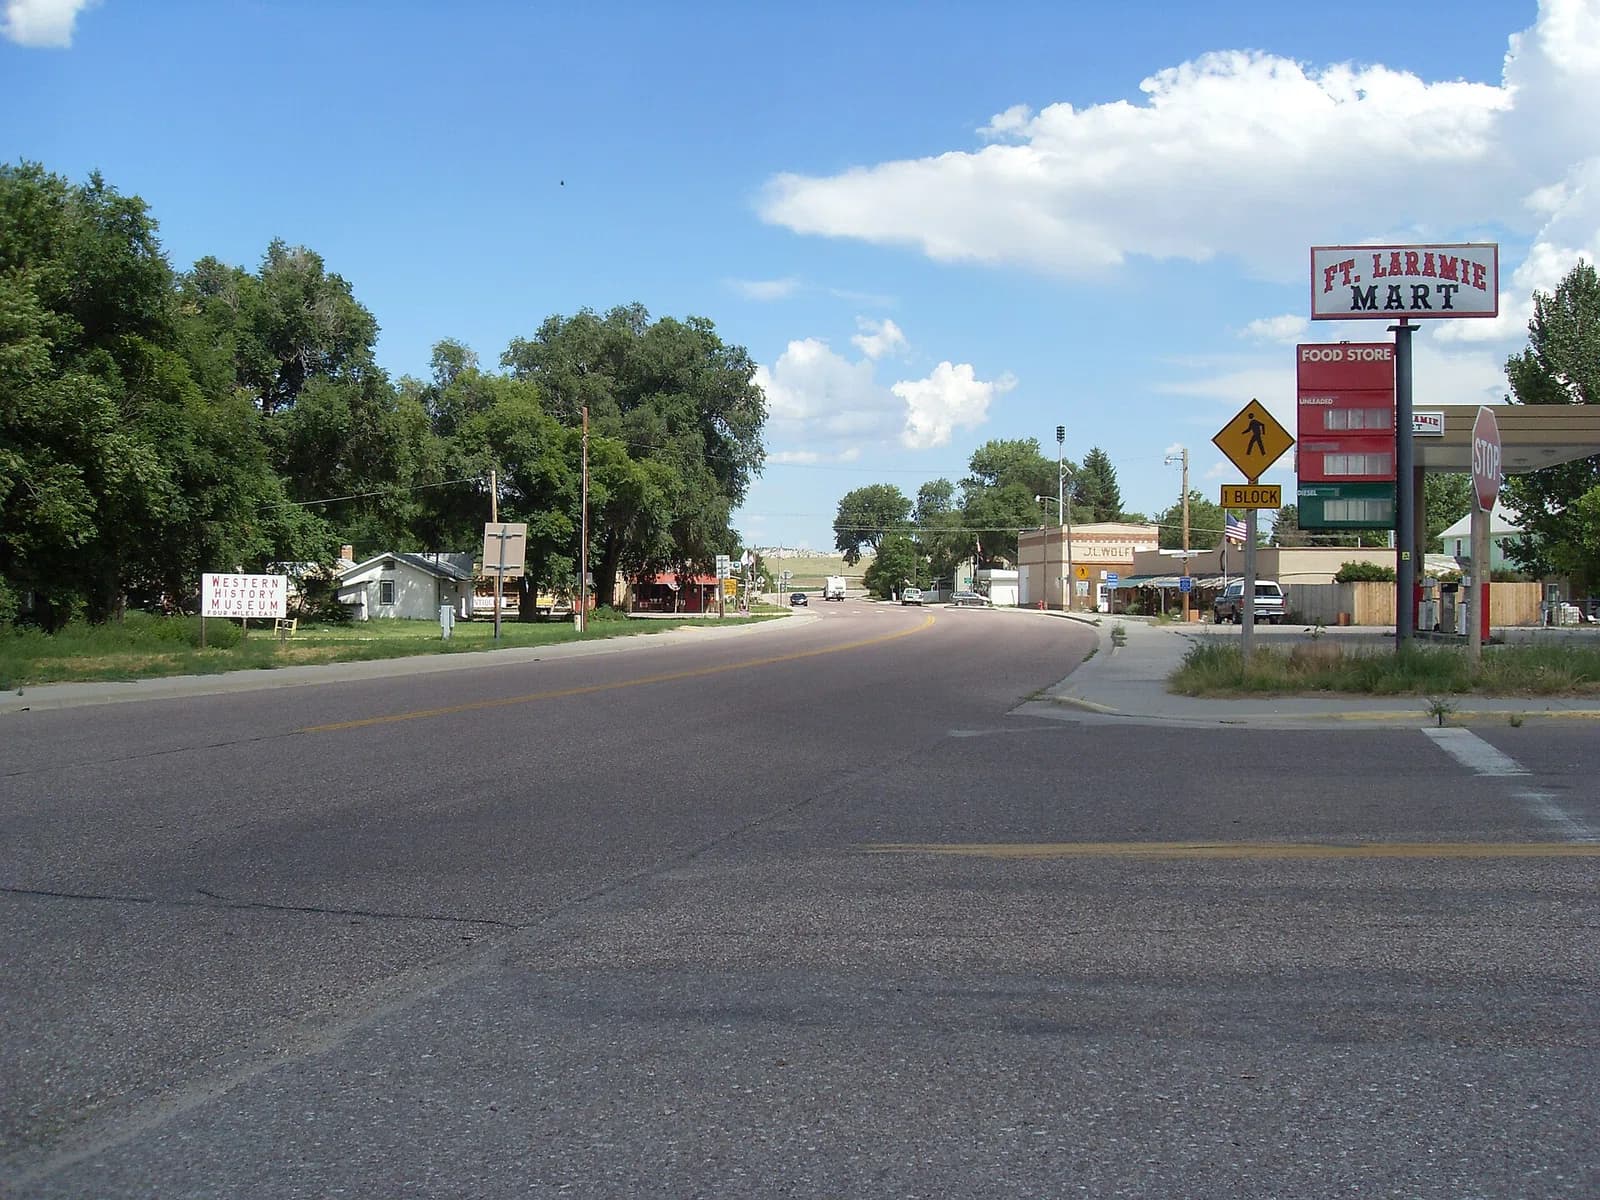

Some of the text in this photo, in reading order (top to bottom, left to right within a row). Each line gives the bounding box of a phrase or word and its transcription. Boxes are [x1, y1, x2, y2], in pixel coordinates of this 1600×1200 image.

[1324, 251, 1487, 294] FT. LARAMIE
[1350, 284, 1459, 311] MART
[1302, 348, 1392, 362] FOOD STORE
[1413, 415, 1439, 426] AMIE
[1474, 437, 1500, 481] STOP
[1224, 490, 1278, 504] 1 BLOCK
[212, 575, 278, 589] WESTERN
[214, 588, 274, 599] HISTORY
[211, 599, 278, 611] MUSEUM
